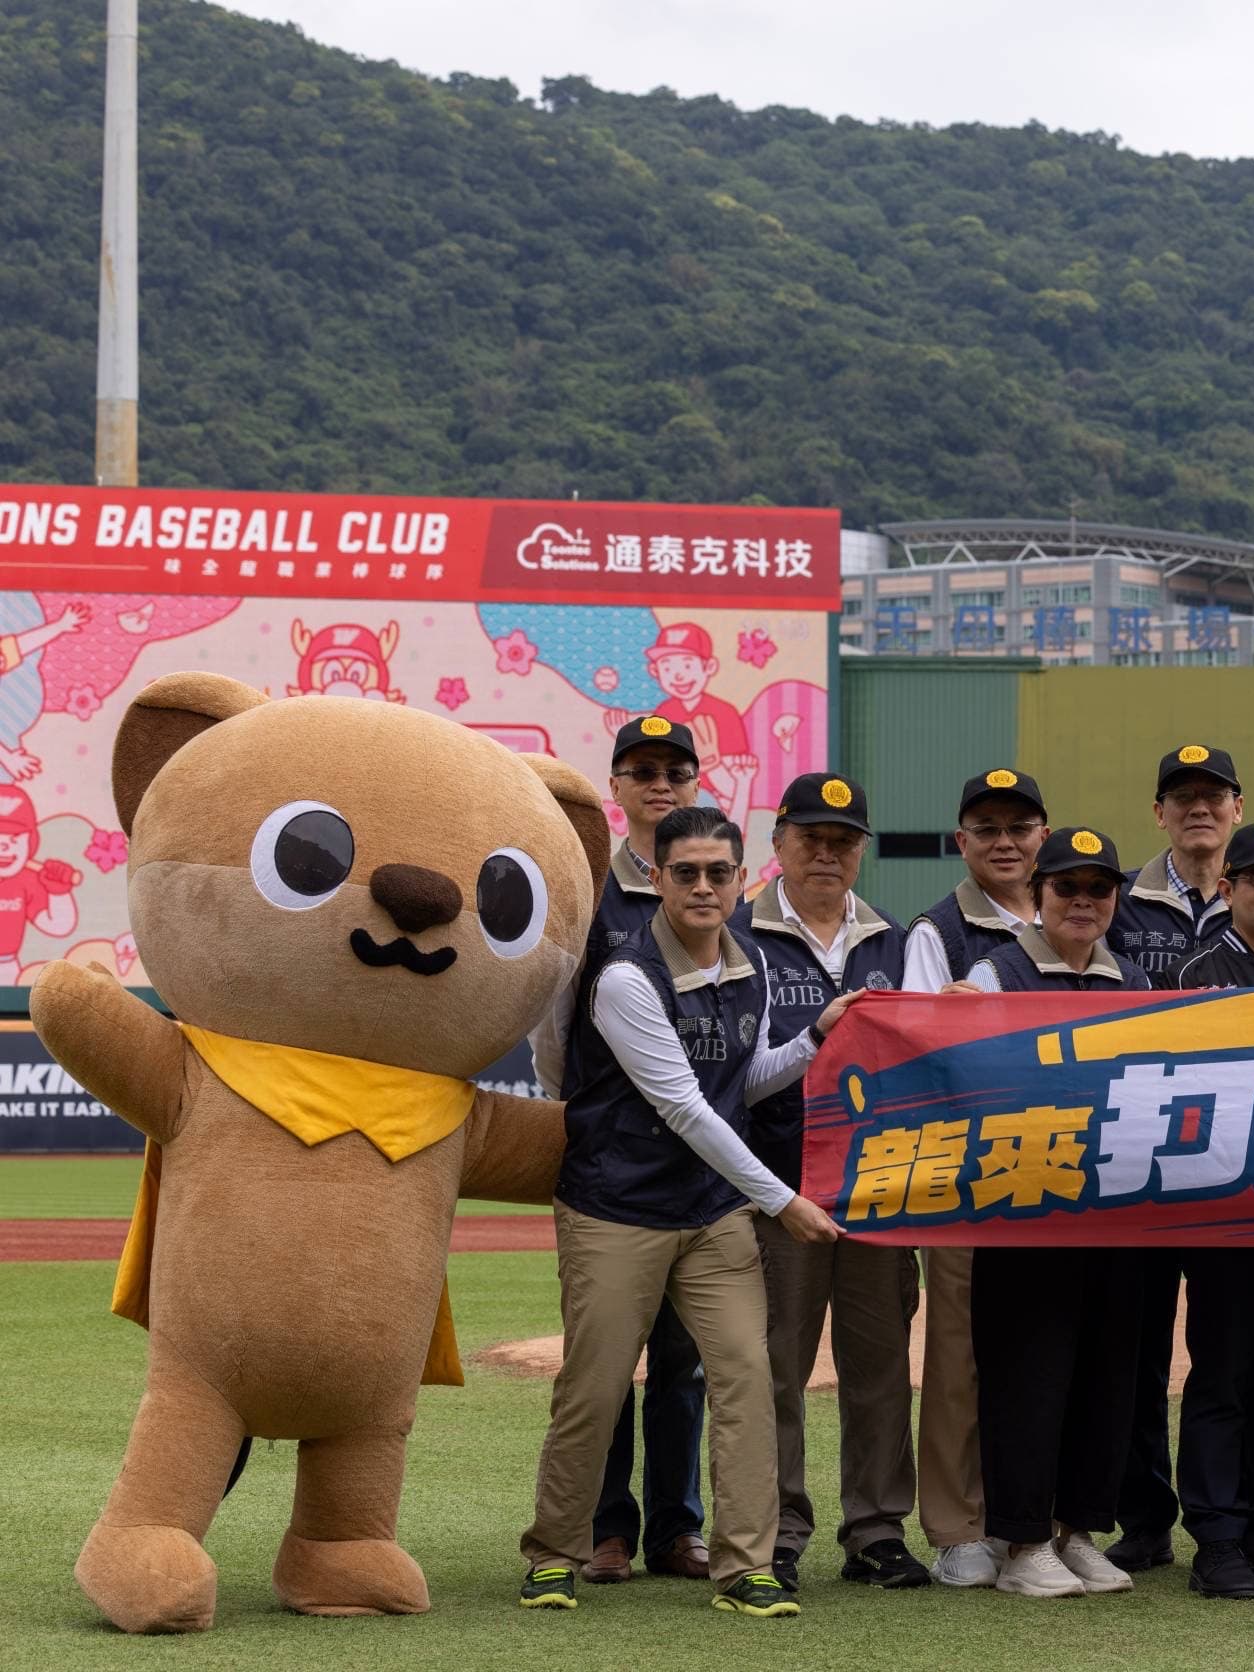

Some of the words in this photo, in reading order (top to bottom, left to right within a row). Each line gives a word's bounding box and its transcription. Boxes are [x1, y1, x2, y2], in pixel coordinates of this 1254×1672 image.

[0, 503, 80, 545] ONS
[96, 505, 319, 552] BASEBALL
[338, 511, 450, 555] CLUB
[604, 534, 813, 578] 通泰克科技
[1123, 931, 1187, 949] 調查局
[41, 1102, 59, 1117] IT
